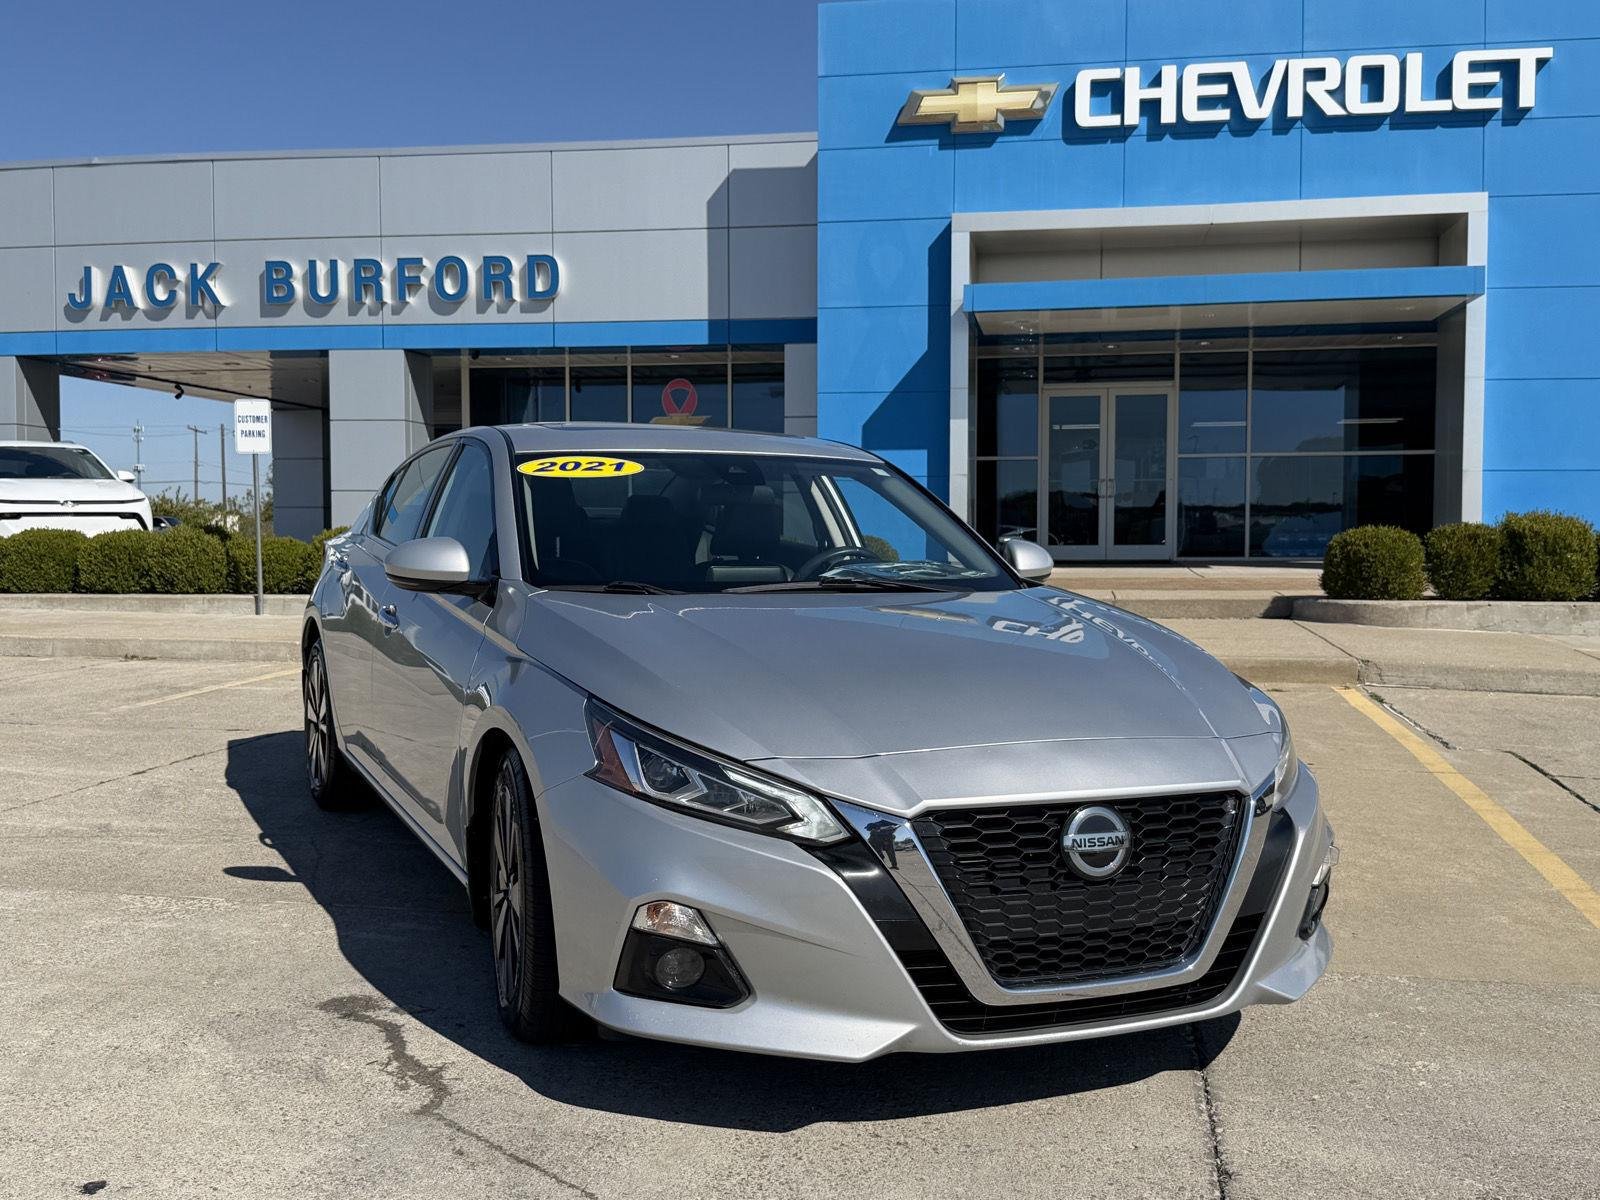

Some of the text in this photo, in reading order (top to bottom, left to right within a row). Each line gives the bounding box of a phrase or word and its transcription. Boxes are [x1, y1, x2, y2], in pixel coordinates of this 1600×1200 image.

[1074, 46, 1554, 129] CHEVROLET
[67, 254, 560, 310] JACK BURFORD
[237, 414, 269, 424] CUSTOMER
[240, 429, 266, 438] PARKING
[532, 461, 627, 473] 2021
[1071, 835, 1125, 849] NISSAN
